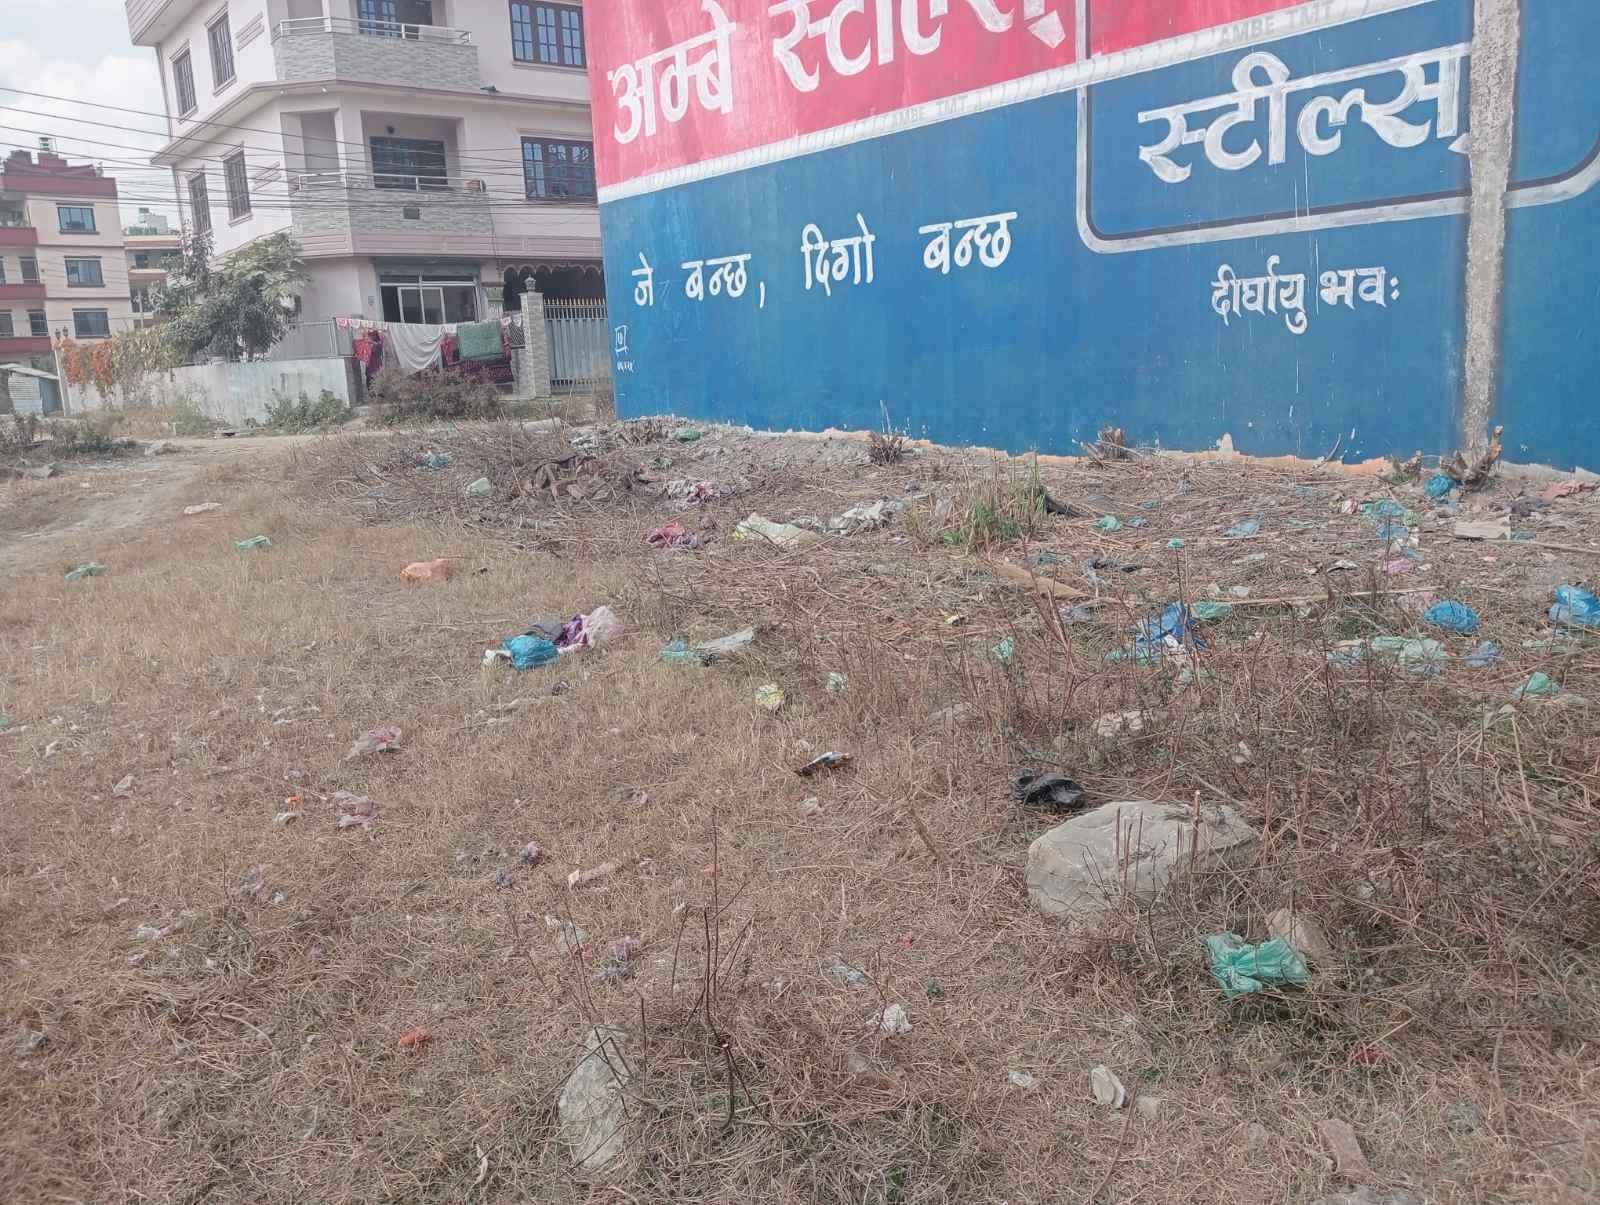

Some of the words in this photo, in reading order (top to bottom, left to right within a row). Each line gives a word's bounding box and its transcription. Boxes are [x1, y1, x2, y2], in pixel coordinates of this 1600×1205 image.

[607, 0, 736, 144] अम्बे
[1218, 15, 1277, 46] AMBE
[631, 252, 654, 306] जे
[801, 213, 876, 296] दिगो
[918, 211, 1018, 274] बन्छ
[1211, 254, 1308, 334] दीर्घायु
